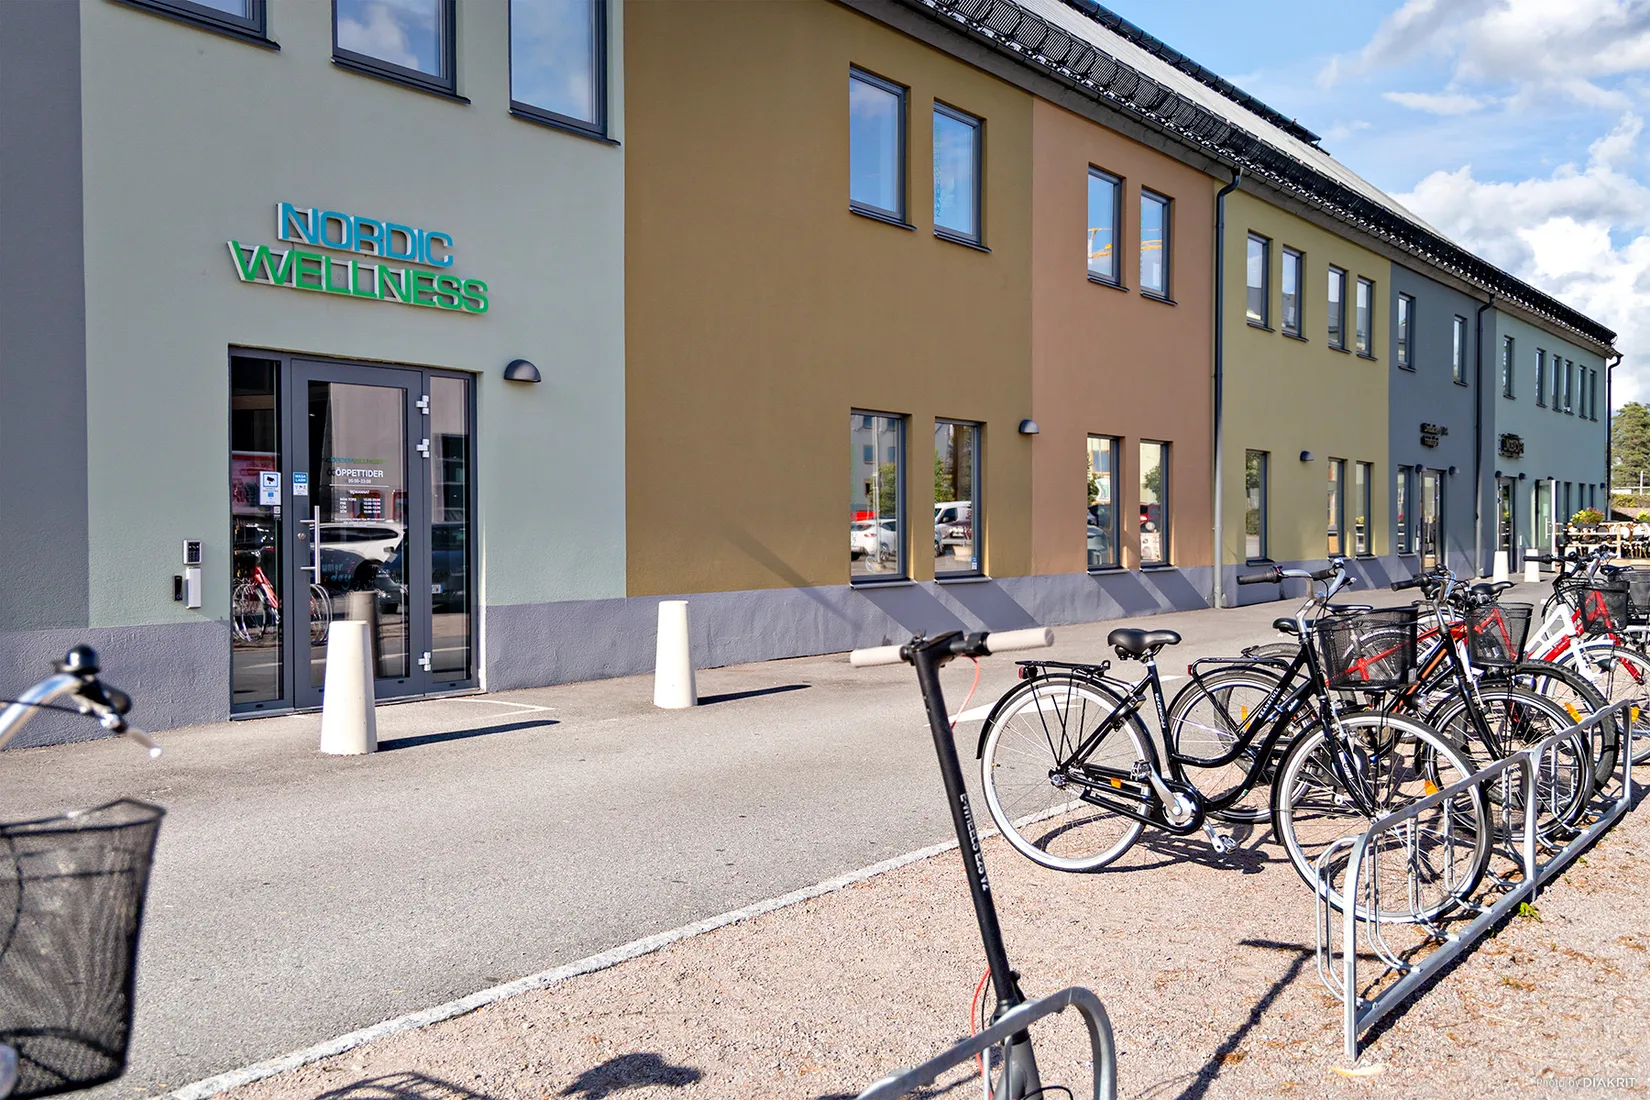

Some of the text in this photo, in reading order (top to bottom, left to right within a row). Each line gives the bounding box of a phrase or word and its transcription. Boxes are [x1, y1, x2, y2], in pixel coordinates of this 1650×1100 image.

[276, 202, 454, 268] NORDIC
[227, 240, 489, 313] WELLNESS
[335, 467, 384, 478] ÖPPETTIDER
